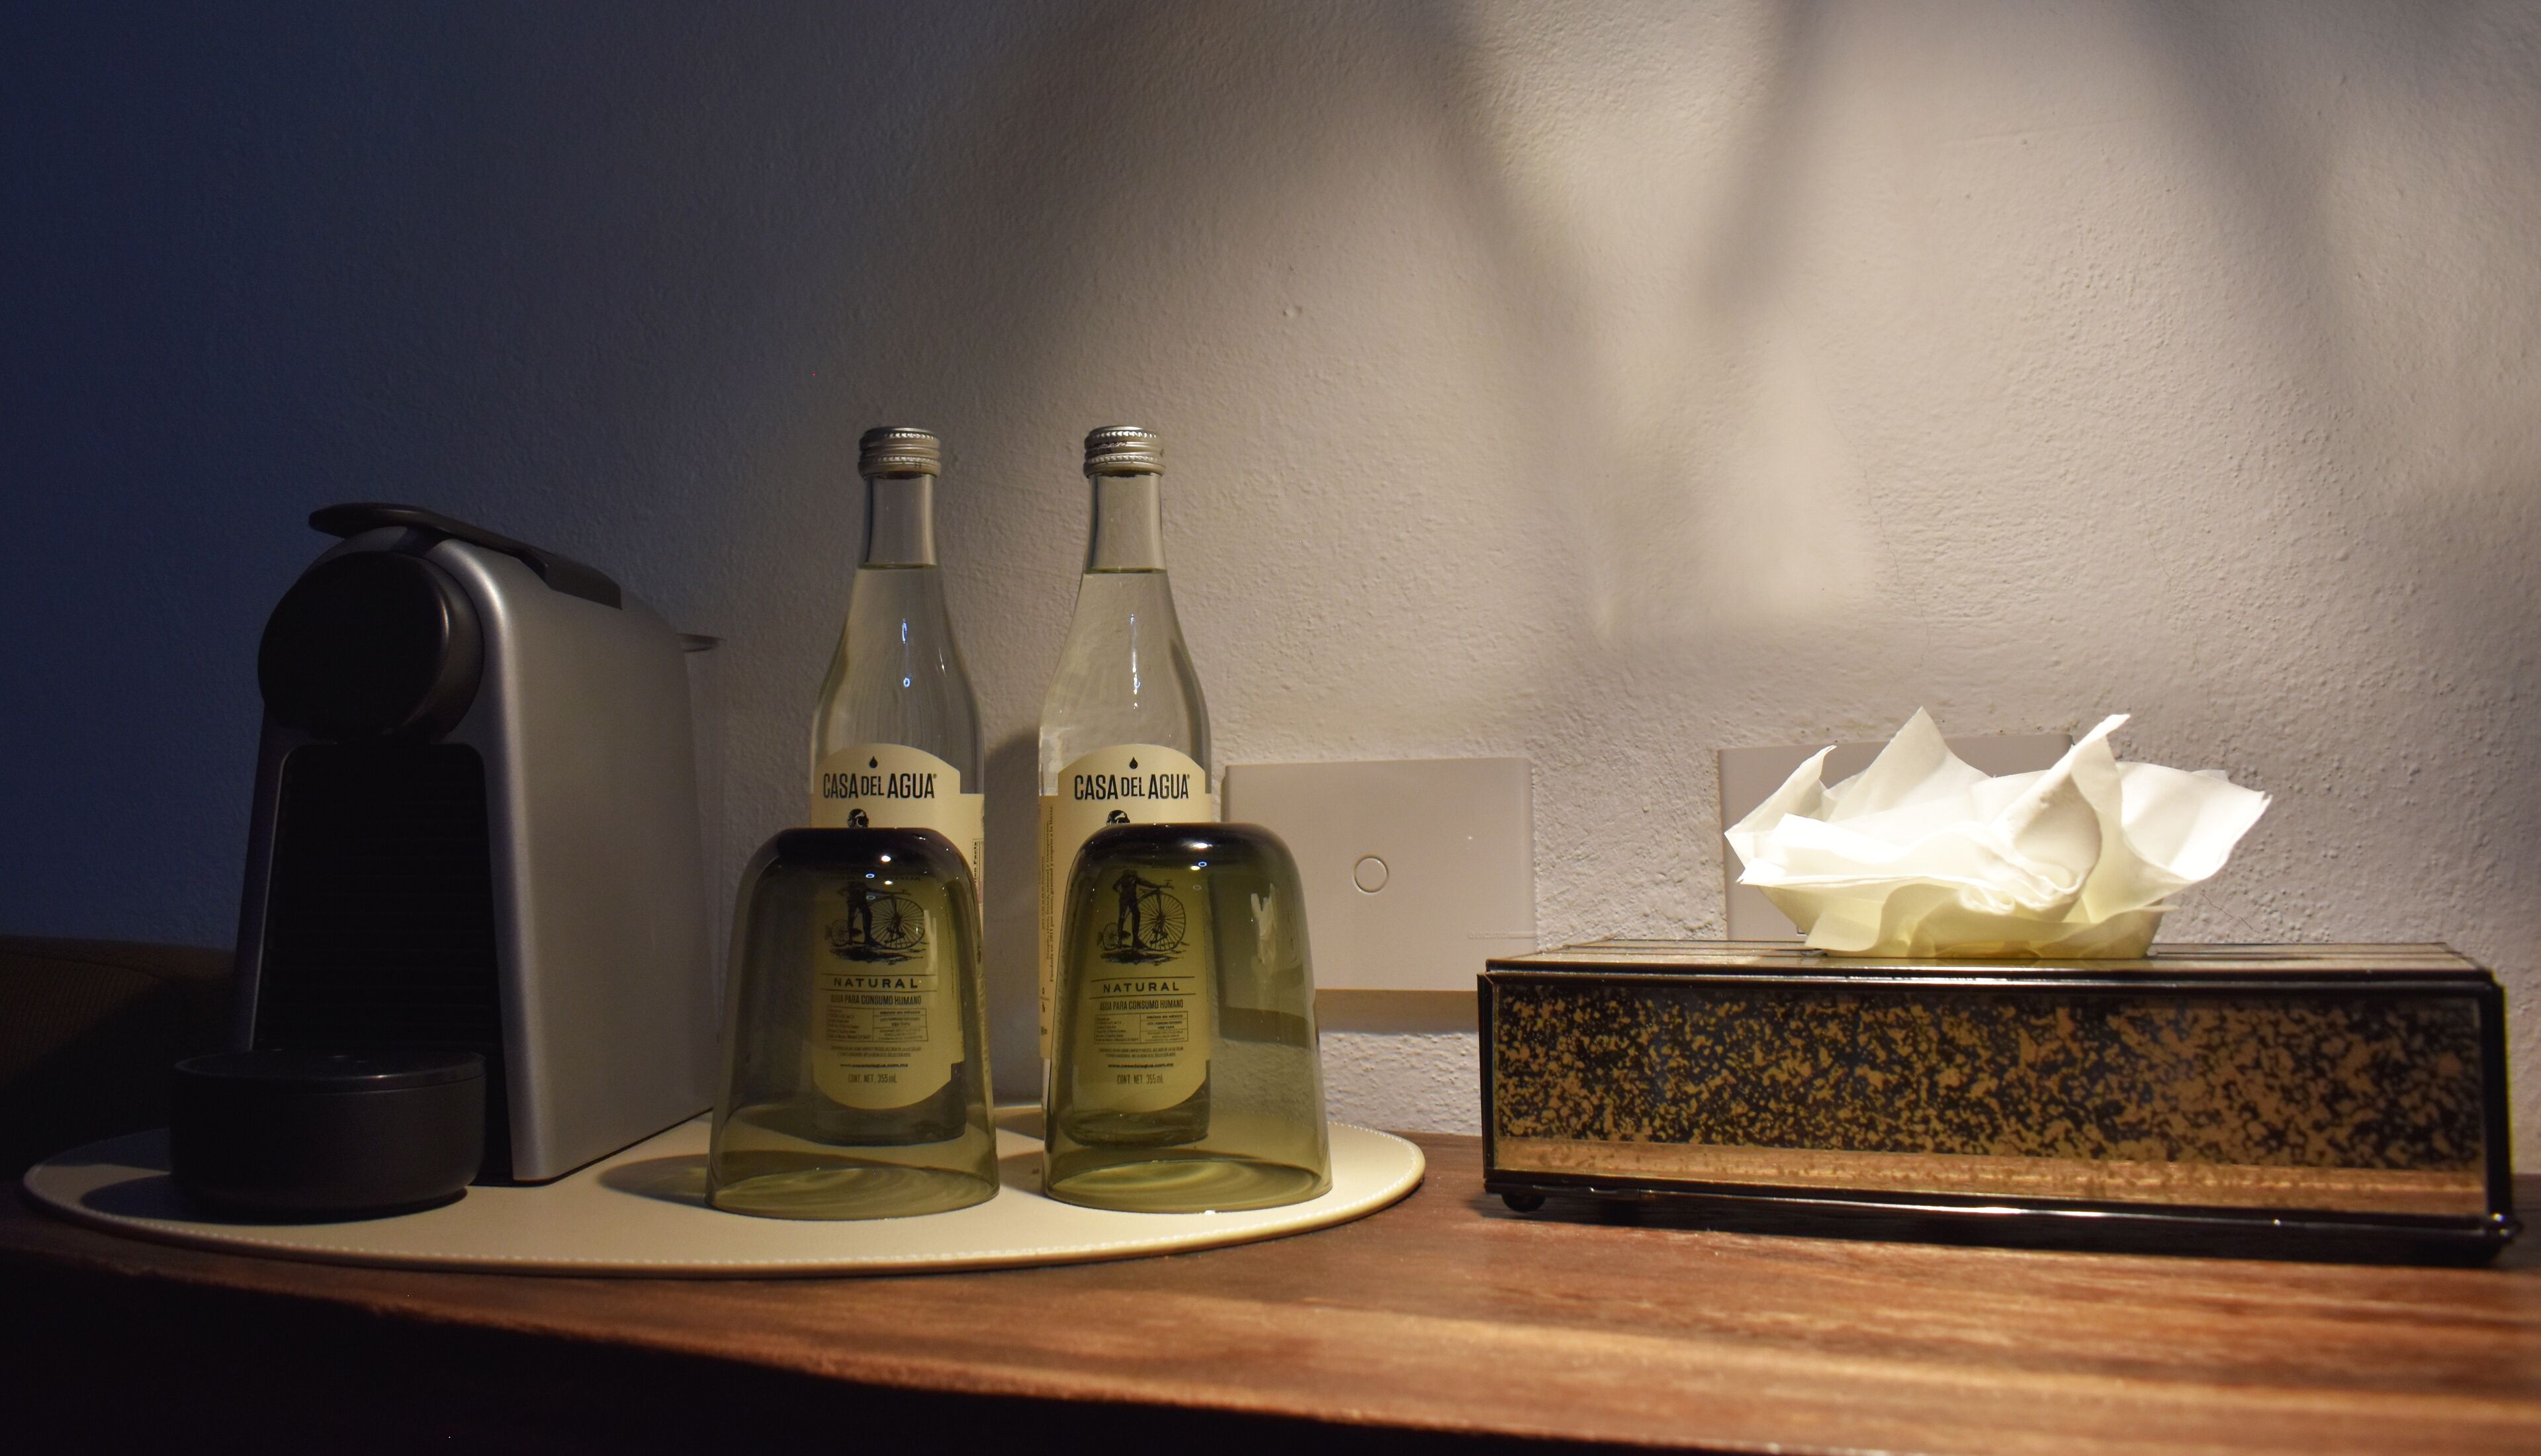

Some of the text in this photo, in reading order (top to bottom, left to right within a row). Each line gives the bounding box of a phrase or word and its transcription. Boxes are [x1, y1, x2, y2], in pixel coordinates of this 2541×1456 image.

[823, 773, 859, 799] CASA
[861, 775, 885, 796] DEL
[1074, 773, 1119, 800] CASA
[1121, 776, 1145, 797] DEL
[834, 978, 918, 989] NATURAL
[1103, 982, 1179, 993] NATURAL
[844, 994, 860, 1004] PARA
[861, 995, 893, 1006] CONSUMO
[895, 995, 922, 1006] HUMANO
[1100, 999, 1184, 1011] AGUA PARA CONSUMO HUMANO
[864, 1074, 876, 1084] NET.
[1117, 1074, 1132, 1086] CONT.
[1134, 1074, 1145, 1085] NET.
